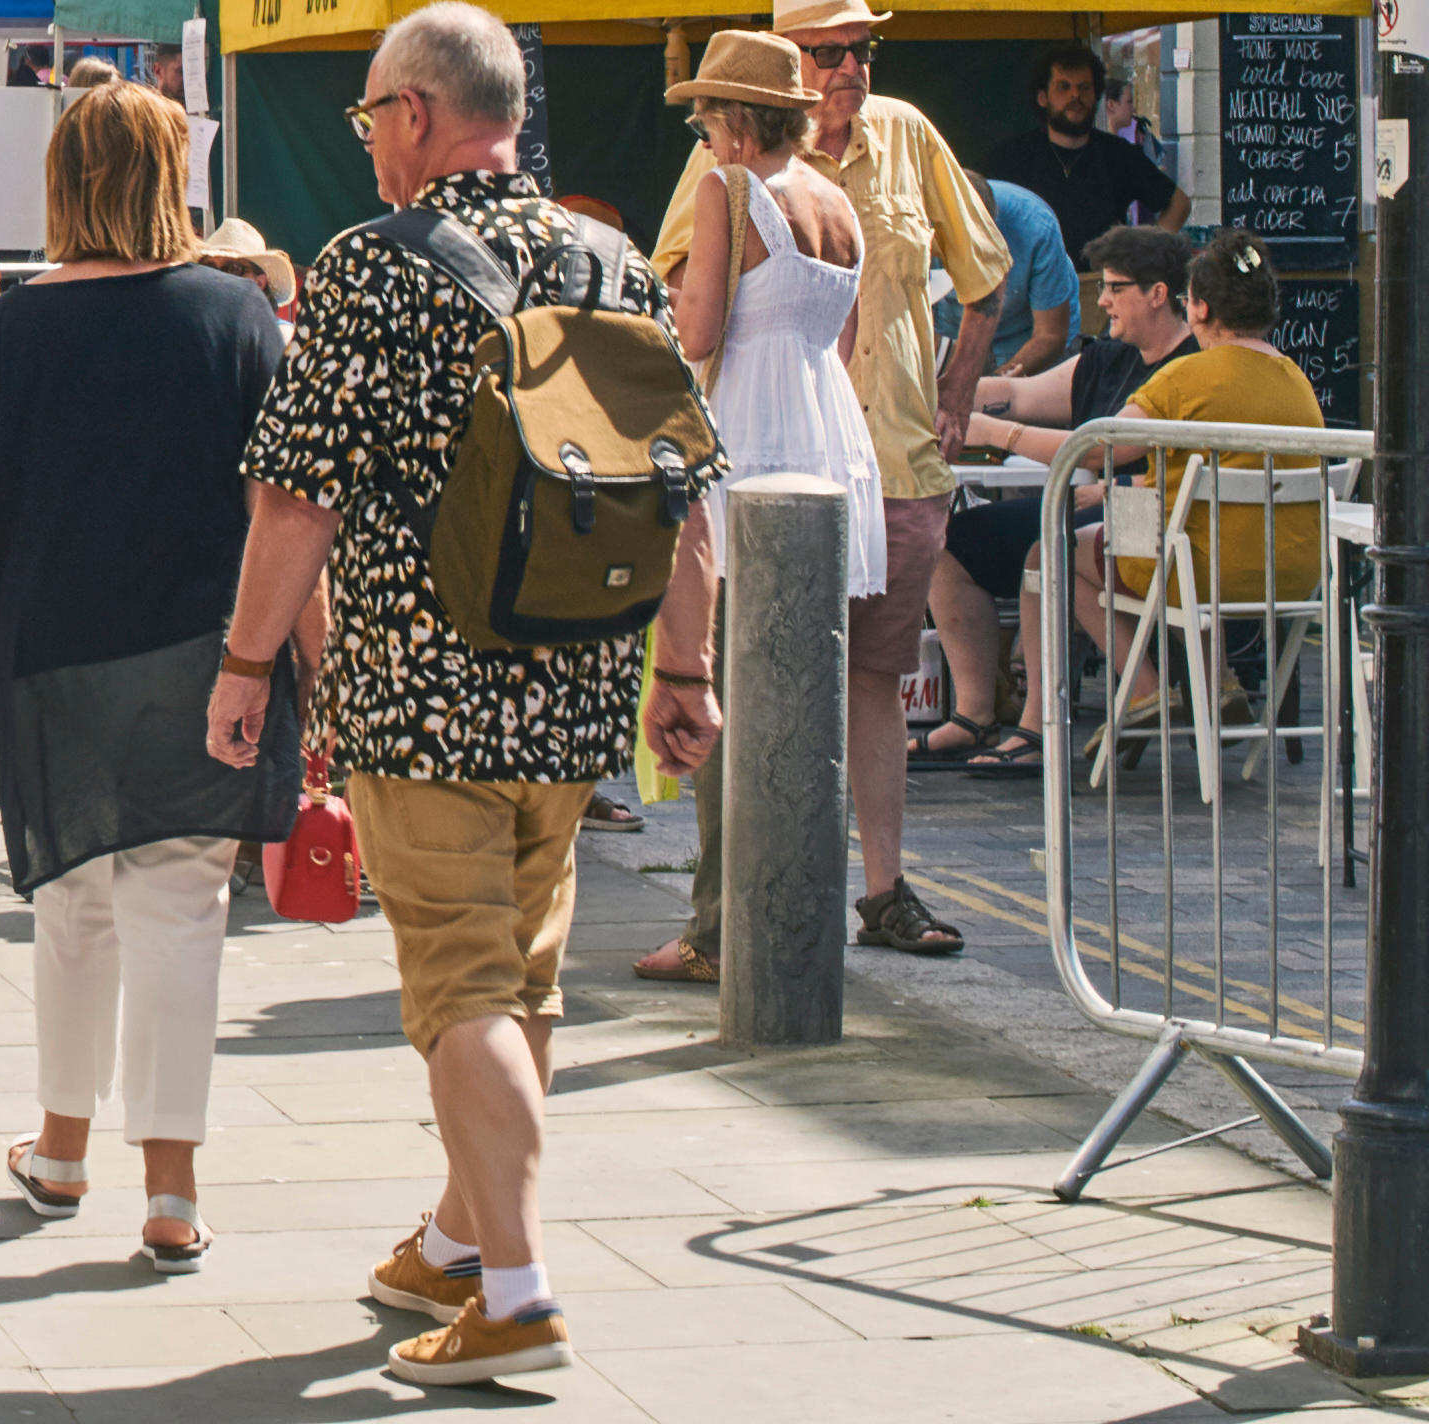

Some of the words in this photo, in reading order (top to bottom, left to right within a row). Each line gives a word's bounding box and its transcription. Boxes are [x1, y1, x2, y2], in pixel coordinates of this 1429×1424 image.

[1249, 14, 1323, 33] SPECIALS
[1238, 40, 1277, 60] HOME
[1285, 40, 1323, 61] MADE
[1229, 90, 1307, 122] MEATBALL
[1315, 92, 1356, 125] SUB
[1254, 209, 1306, 231] CIDER
